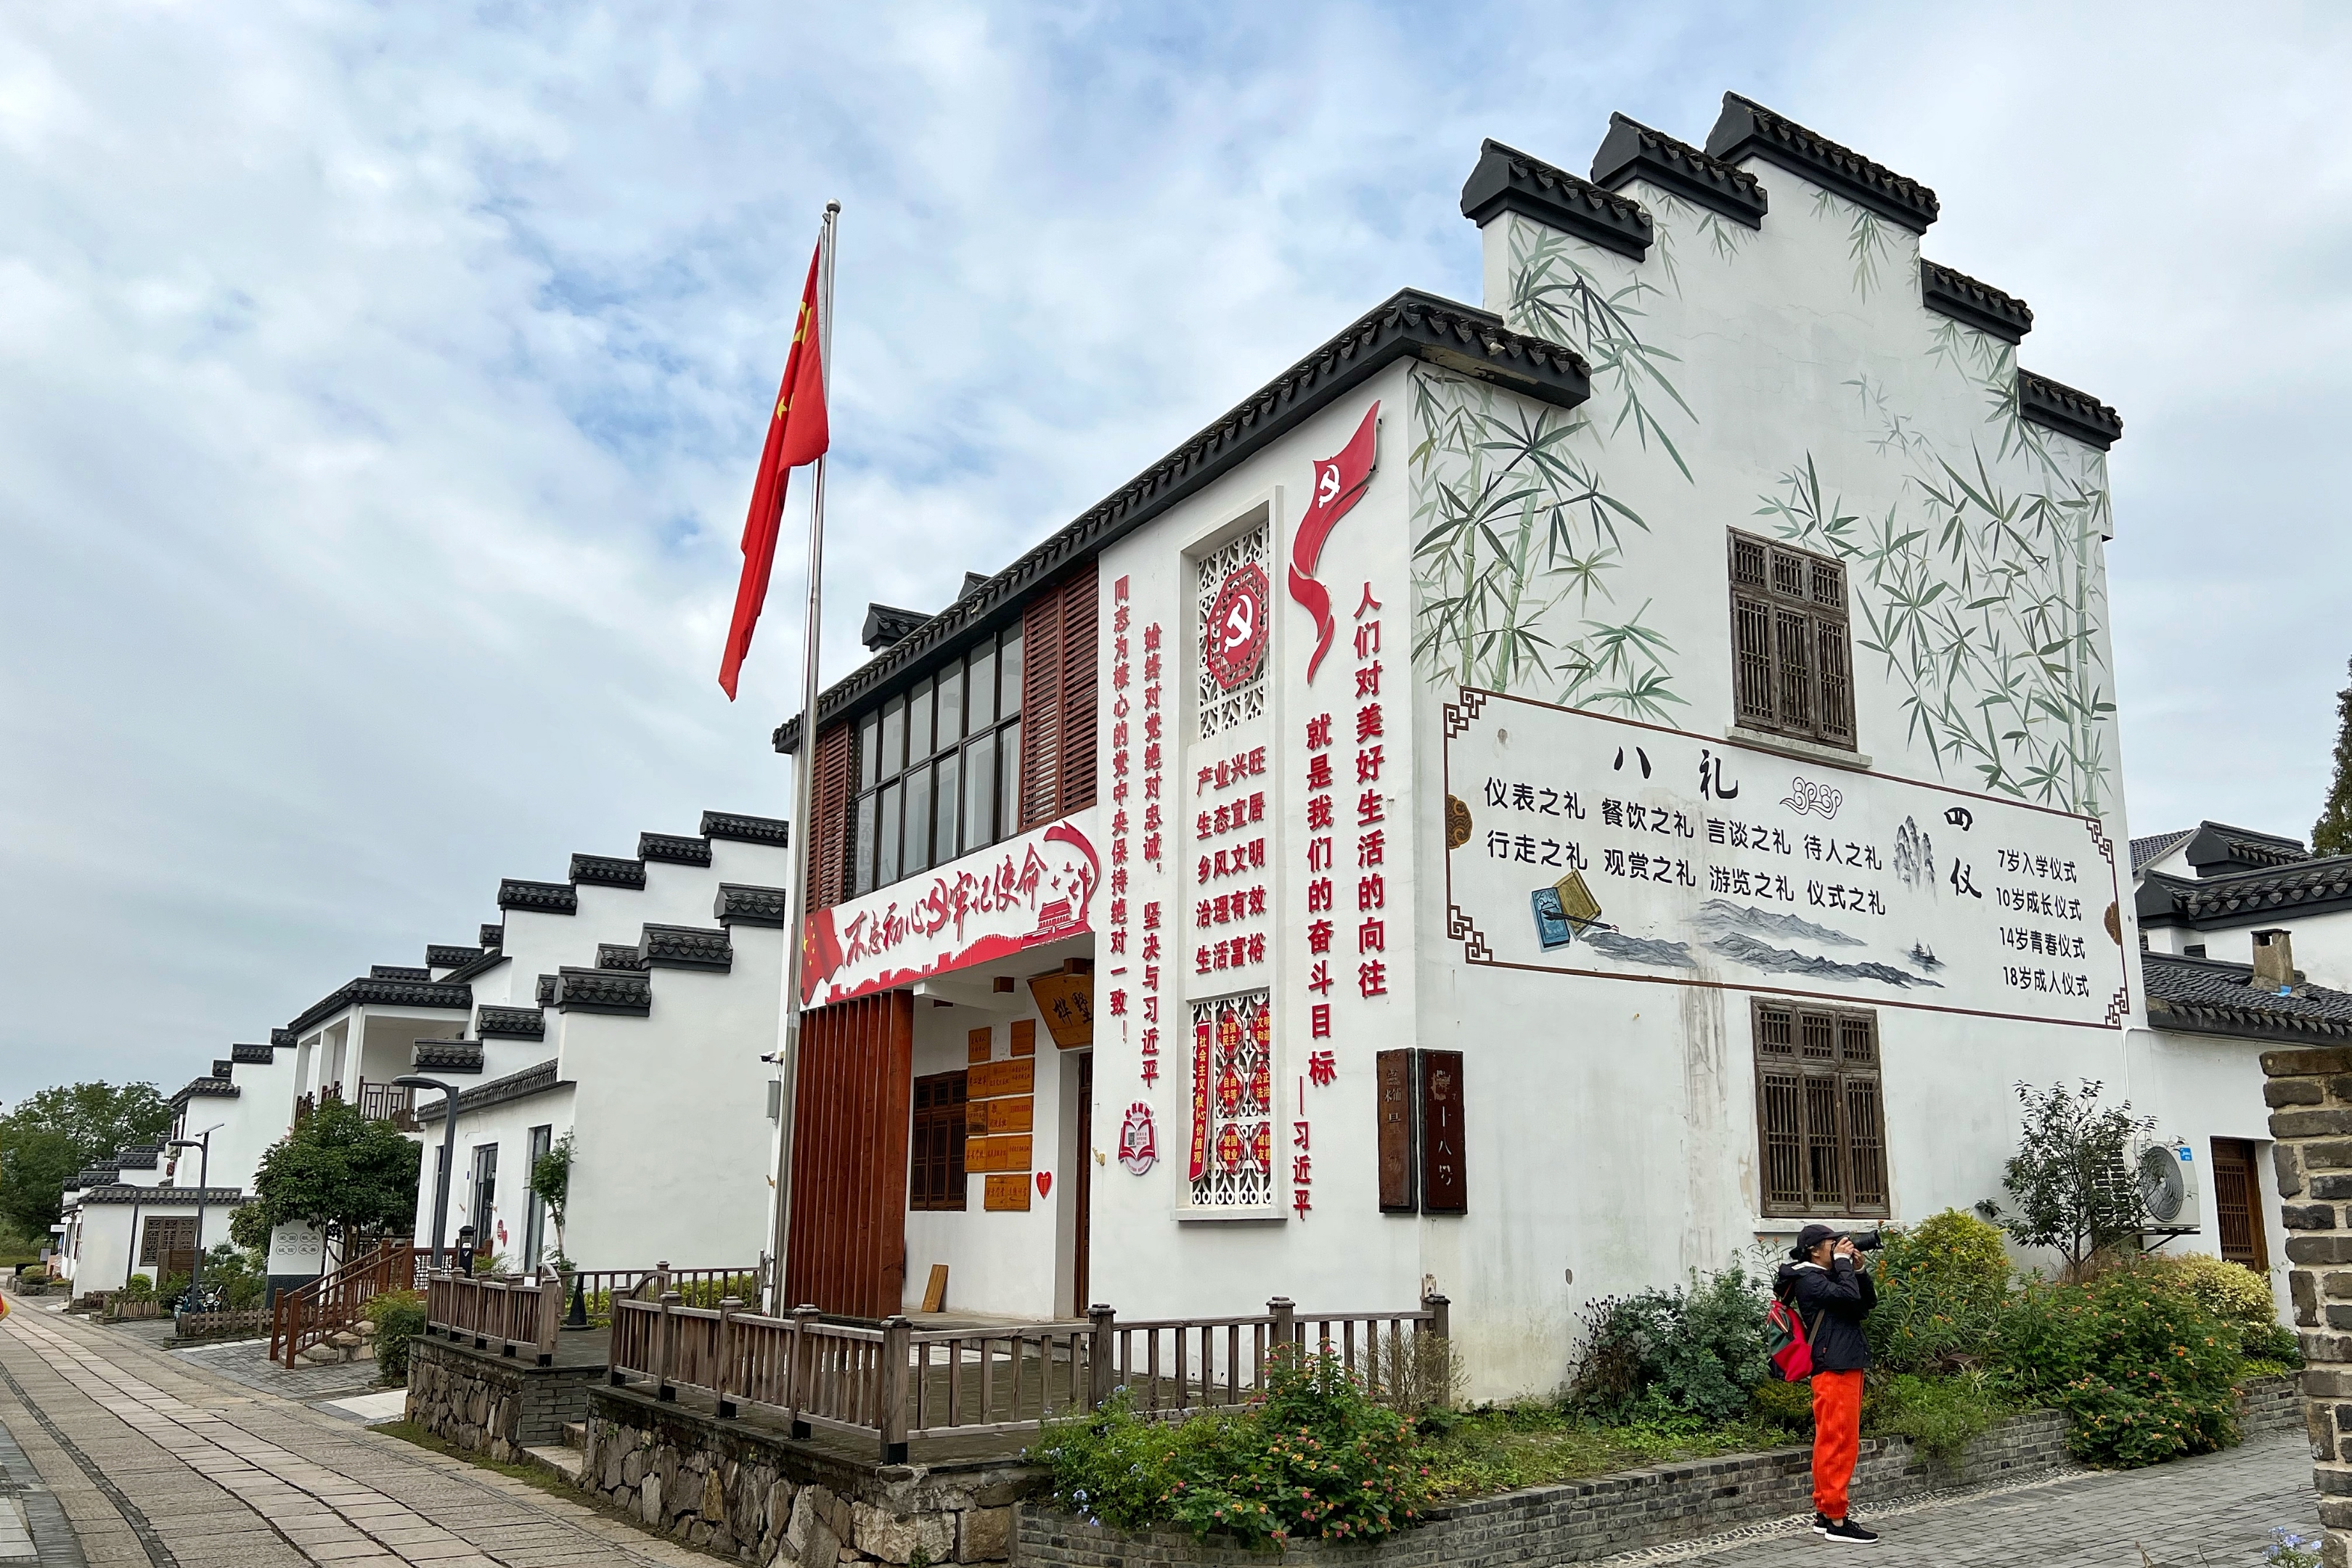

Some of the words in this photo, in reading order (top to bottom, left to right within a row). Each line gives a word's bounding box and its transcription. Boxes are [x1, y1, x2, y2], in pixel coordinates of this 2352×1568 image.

[1196, 746, 1266, 797] 产业兴旺
[1352, 581, 1387, 997] 人们对美好生活的向往
[1613, 746, 1739, 801] 八礼
[1196, 791, 1265, 840] 生态宜居
[1484, 777, 1585, 820] 仪表之礼
[1601, 797, 1694, 838] 餐饮之礼
[1707, 817, 1792, 855] 言谈之礼
[1804, 833, 1882, 870] 待人之礼
[1198, 838, 1266, 884] 乡风文明
[1487, 830, 1588, 870] 行走之礼
[1604, 849, 1696, 887] 观赏之礼
[1709, 865, 1795, 902] 游览之礼
[1806, 879, 1886, 915] 仪式之礼
[1998, 849, 2078, 883] 7岁入学仪式
[844, 901, 927, 967] 不忘初心
[950, 842, 1048, 942] 牢记使命
[1196, 884, 1267, 928] 治理有效
[1306, 713, 1337, 1087] 就是我们的奋斗目标
[1996, 886, 2082, 922] 10岁成长仪式
[1196, 932, 1266, 974] 生活富裕
[1999, 926, 2086, 960] 14岁青春仪式
[2003, 966, 2089, 998] 18岁成人仪式
[1222, 1022, 1237, 1035] 富强
[1257, 1016, 1270, 1028] 文明
[1222, 1034, 1237, 1047] 民主
[1223, 1076, 1237, 1088] 自由
[1223, 1090, 1238, 1102] 平等
[1256, 1073, 1270, 1085] 公正
[1257, 1086, 1270, 1098] 法治
[1193, 1034, 1208, 1164] 社会主义核心价值观
[1224, 1135, 1238, 1147] 爱国
[1224, 1148, 1238, 1161] 敬业
[1257, 1134, 1270, 1146] 诚信
